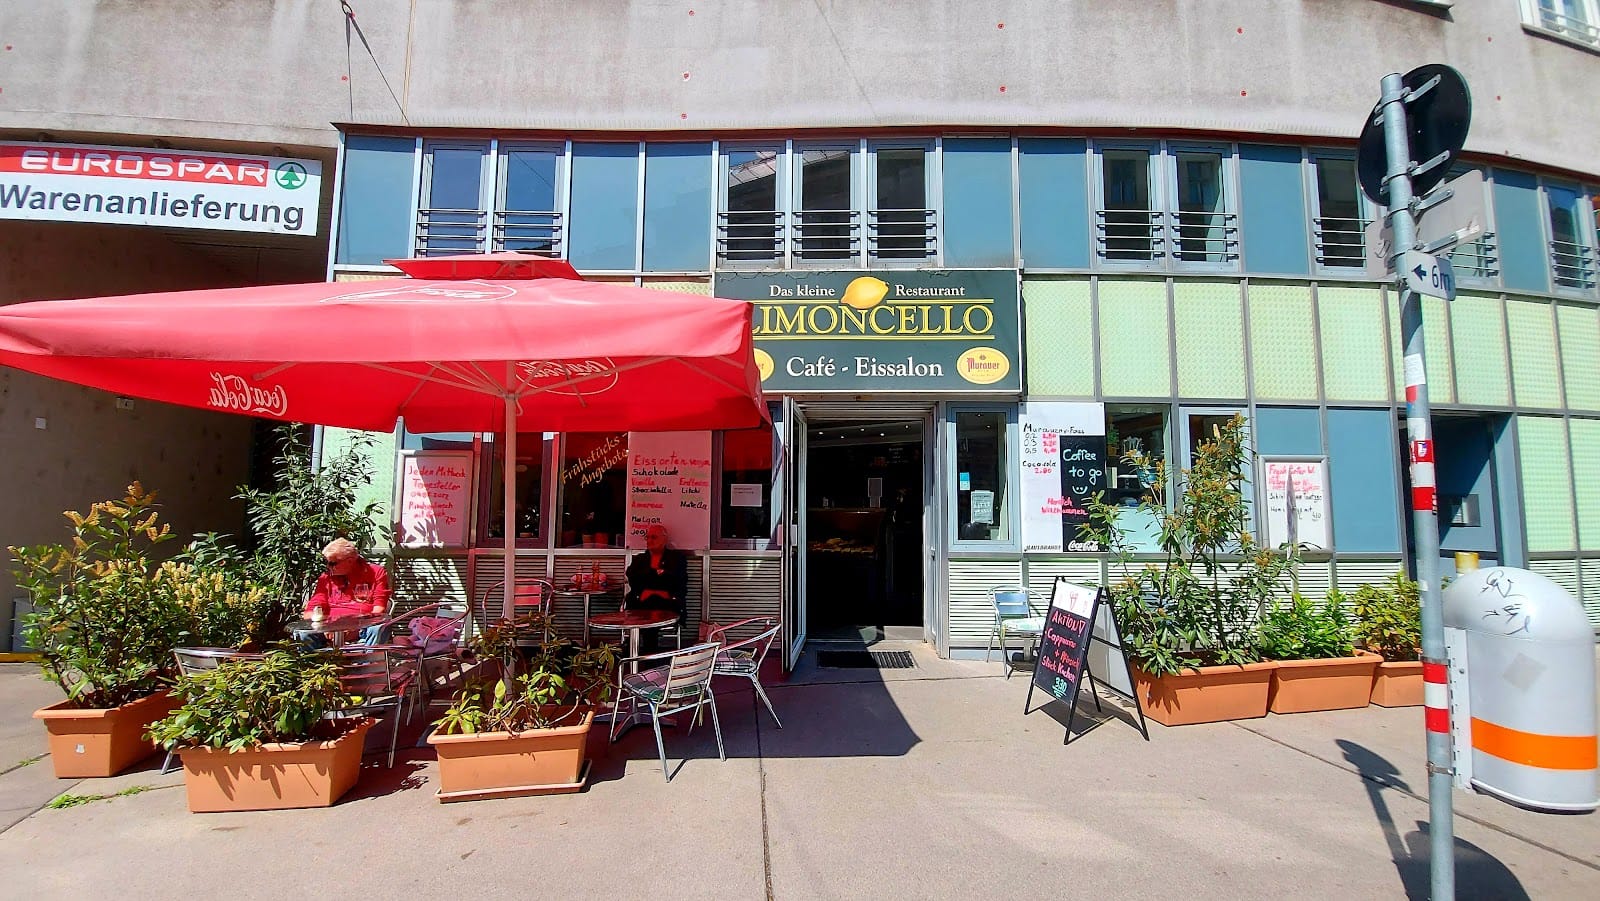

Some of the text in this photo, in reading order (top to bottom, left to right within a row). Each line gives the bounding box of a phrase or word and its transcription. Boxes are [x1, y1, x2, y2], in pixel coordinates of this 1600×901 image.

[20, 149, 267, 184] EUROSPAR
[0, 183, 305, 231] Warenanlieferung
[1431, 265, 1452, 292] 6m
[769, 284, 966, 297] Das kleine Restaurant
[752, 305, 994, 335] IMONCELLO
[786, 356, 836, 377] Café
[855, 356, 944, 377] Eissalon
[967, 357, 1000, 372] Murauer
[1063, 448, 1097, 461] Coffee
[1069, 466, 1103, 486] to go
